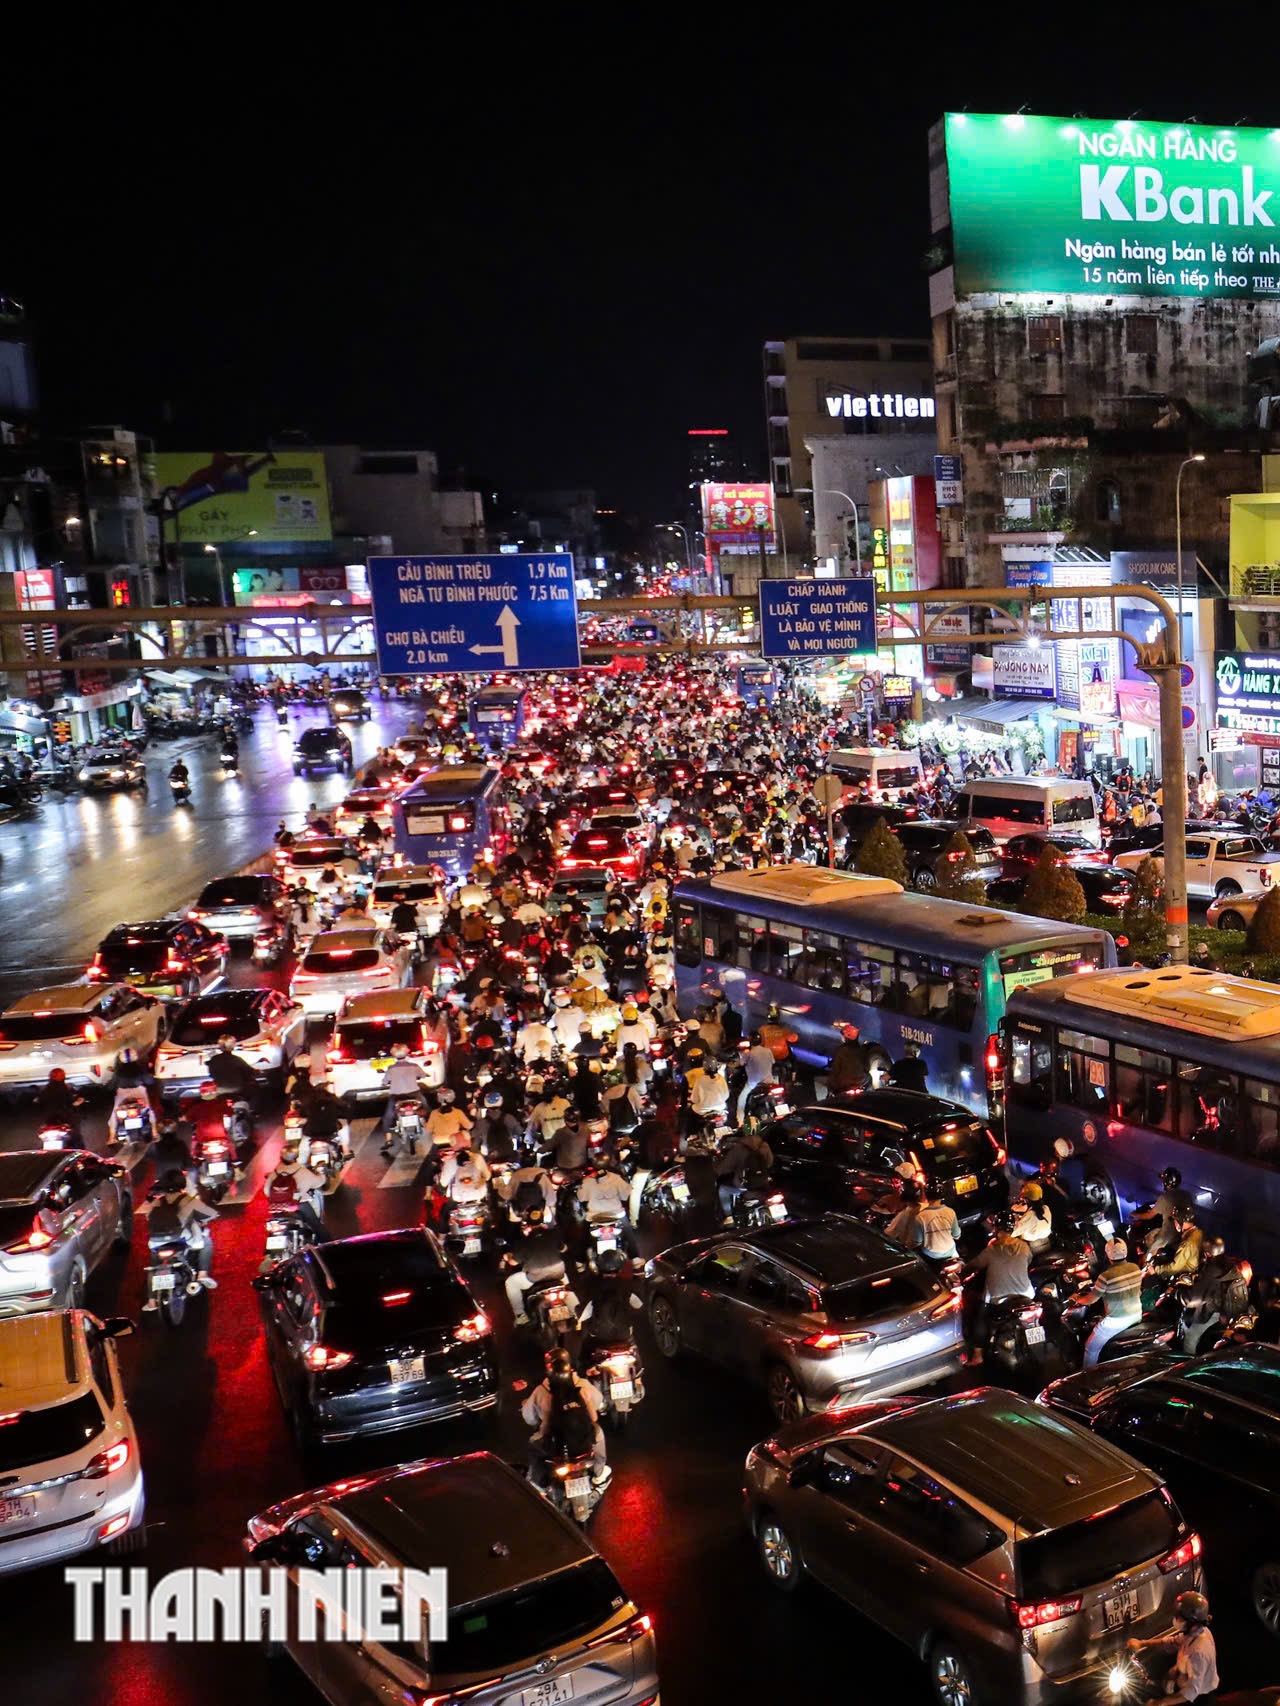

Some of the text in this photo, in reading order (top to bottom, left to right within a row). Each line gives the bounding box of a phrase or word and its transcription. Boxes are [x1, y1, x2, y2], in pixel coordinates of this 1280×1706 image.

[1164, 129, 1237, 162] HÀNG
[1080, 164, 1276, 227] KBank
[1065, 238, 1116, 263] Ngân
[1121, 239, 1167, 265] hàng
[1172, 240, 1206, 262] bán
[1212, 242, 1227, 262] lẻ
[1232, 243, 1255, 263] tốt
[1083, 267, 1102, 283] 15
[1107, 268, 1142, 284] năm
[1147, 265, 1175, 285] liên
[1180, 267, 1209, 290] tiếp
[1214, 268, 1248, 287] theo
[1252, 276, 1275, 288] THE
[826, 394, 935, 417] viettien
[397, 560, 421, 581] CẦU
[425, 562, 453, 580] BÌNH
[456, 561, 491, 583] TRIỆU
[548, 563, 567, 578] Km
[400, 585, 425, 603] NGÃ
[426, 586, 443, 602] TƯ
[447, 583, 475, 602] BÌNH
[478, 581, 518, 601] PHƯỚC
[550, 585, 569, 600] Km
[788, 582, 846, 597] CHẤP HÀNH
[769, 600, 868, 617] LUẬT GIAO THÔNG
[386, 624, 465, 647] CHỢ BÀ CHIỂU
[778, 617, 861, 634] LÀ BẢO VỆ MÌNH
[788, 634, 857, 652] VÀ MỌI NGƯỜI
[428, 650, 448, 664] km
[1243, 670, 1270, 693] HÀNG
[900, 1025, 934, 1047] 51B-210.41
[399, 1359, 415, 1373] 30F
[1113, 1594, 1130, 1610] 51H
[537, 1684, 558, 1697] 49A
